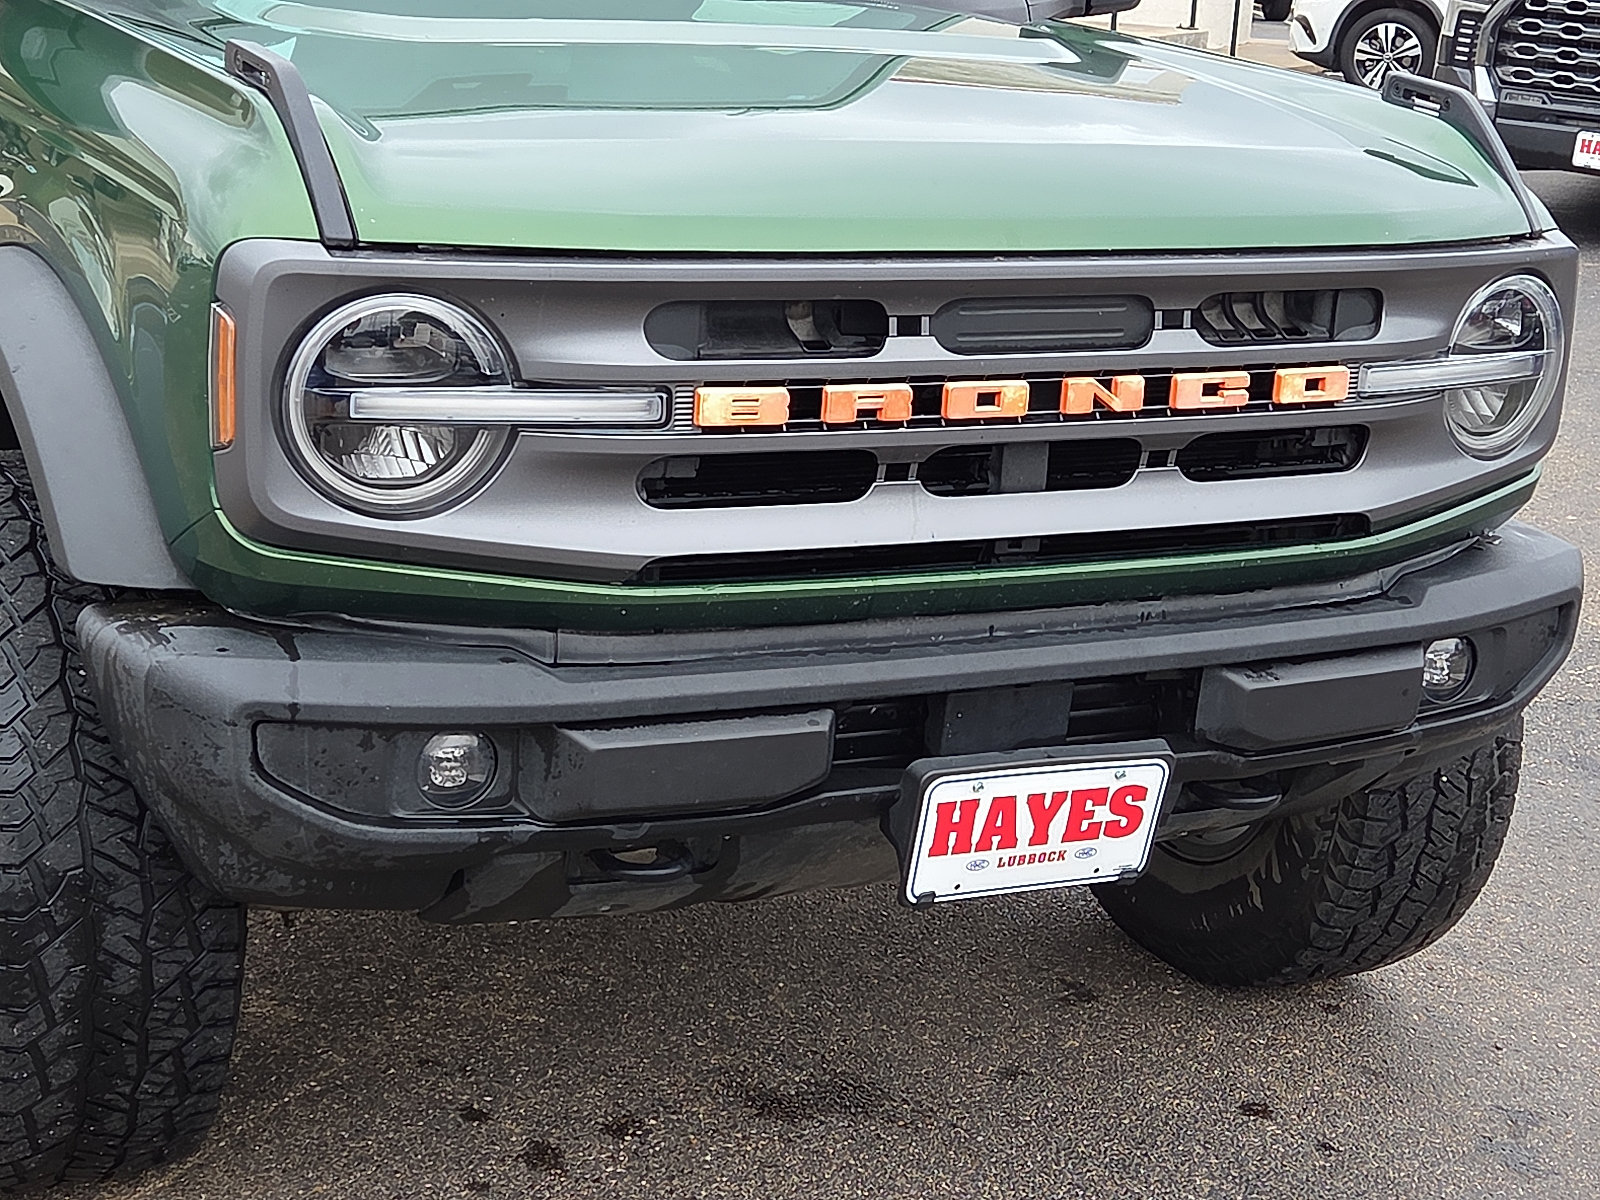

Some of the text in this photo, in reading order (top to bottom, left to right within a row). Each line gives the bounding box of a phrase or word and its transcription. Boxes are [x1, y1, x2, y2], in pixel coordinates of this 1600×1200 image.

[693, 365, 1351, 430] BRONCO
[928, 784, 1149, 858] HAYES
[997, 849, 1067, 868] LUBBOCK
